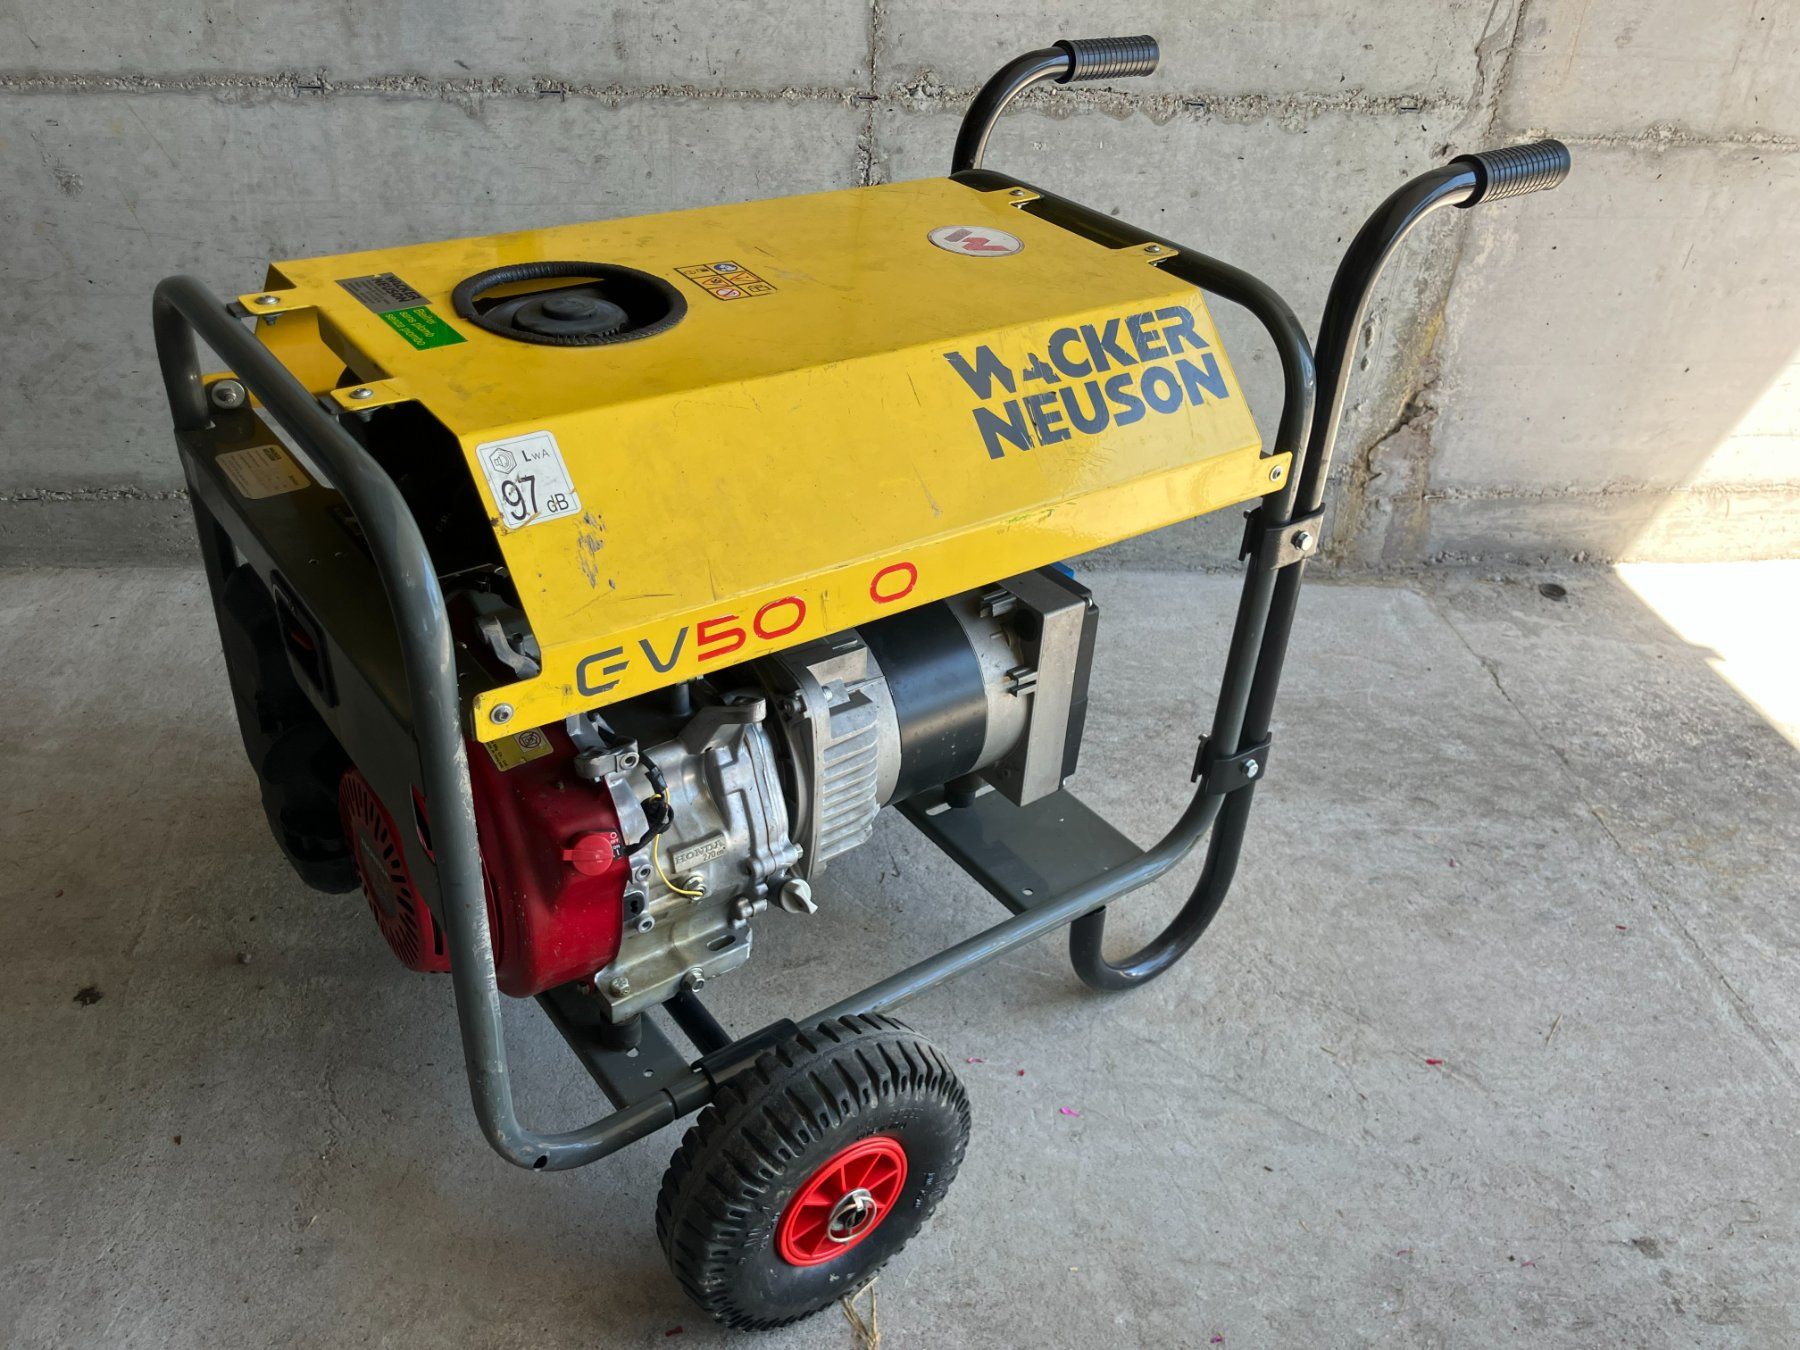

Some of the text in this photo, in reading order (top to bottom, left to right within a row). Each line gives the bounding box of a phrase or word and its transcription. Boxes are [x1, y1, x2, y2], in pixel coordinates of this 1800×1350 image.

[385, 313, 426, 346] senza piombo
[399, 311, 435, 338] sans plomb
[943, 305, 1210, 400] WACKER
[972, 352, 1230, 460] NEUSON
[501, 474, 569, 521] 97 dB
